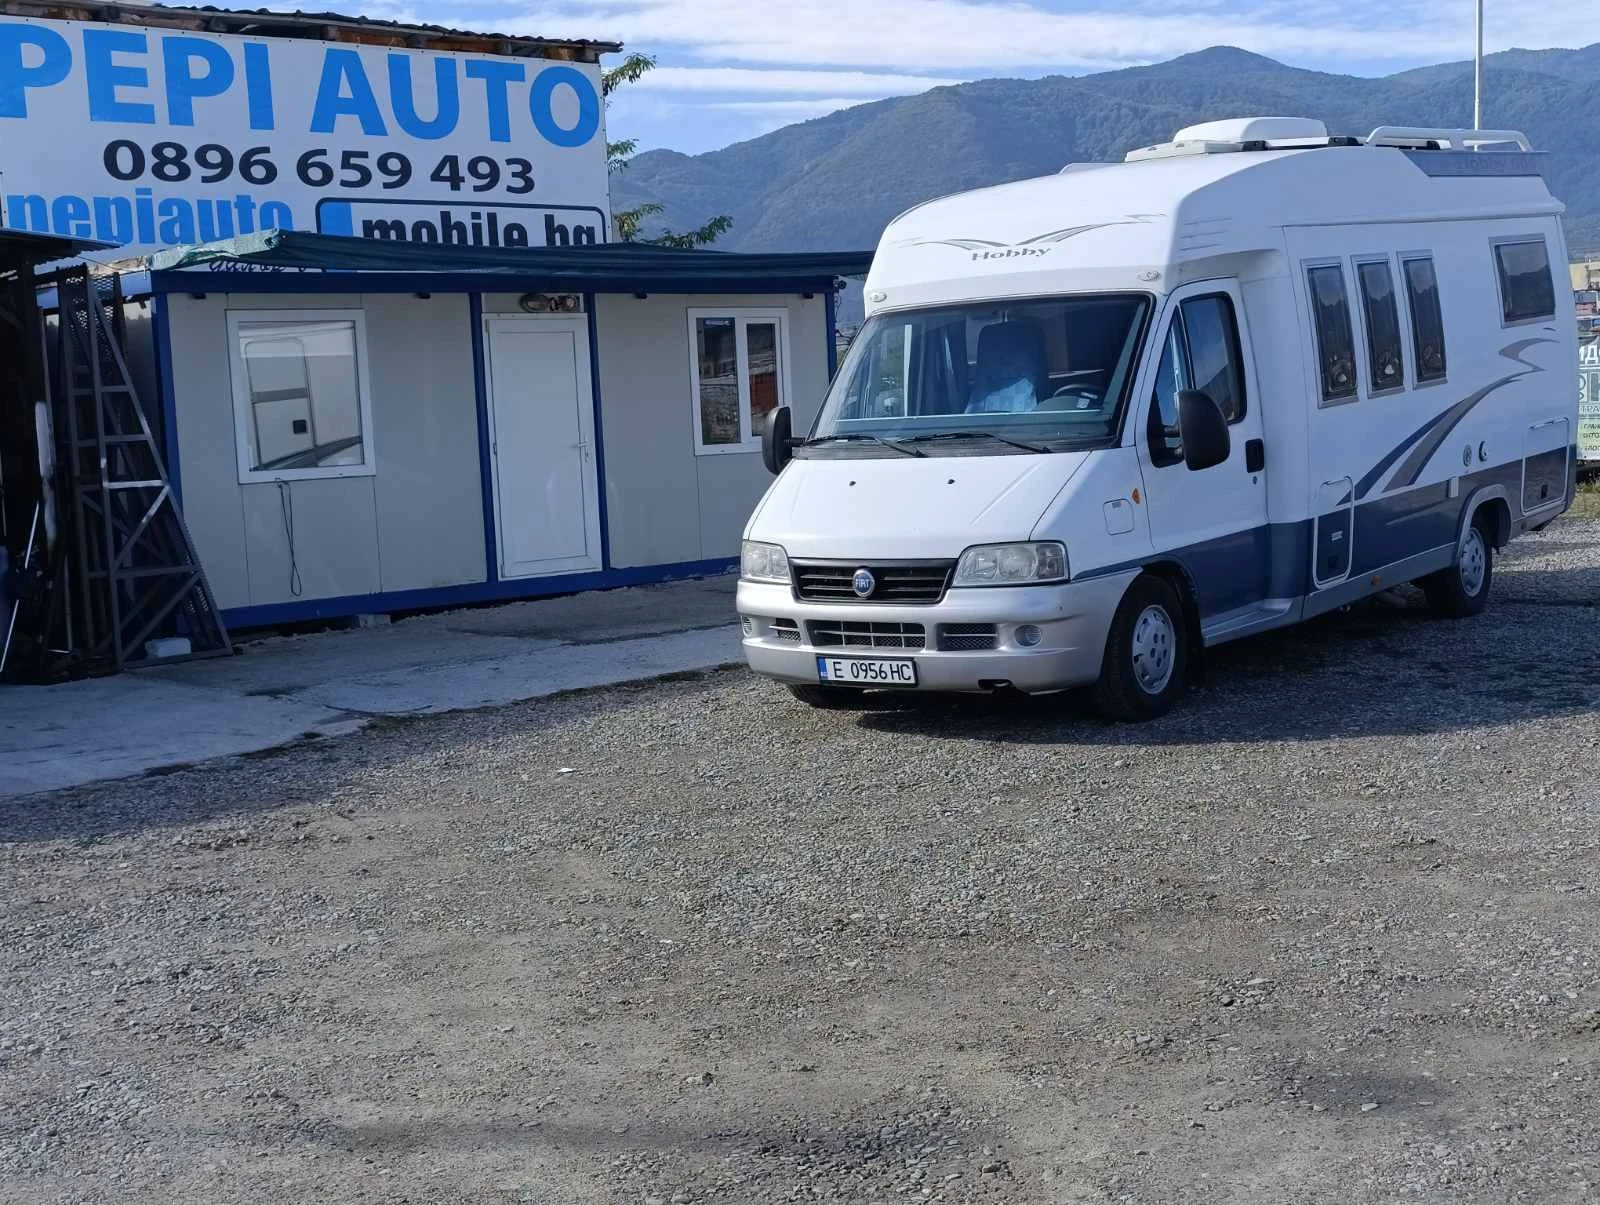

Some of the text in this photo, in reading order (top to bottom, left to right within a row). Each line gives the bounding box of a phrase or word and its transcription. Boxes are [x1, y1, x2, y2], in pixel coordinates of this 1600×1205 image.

[0, 23, 600, 148] PEPI AUTO
[103, 140, 536, 194] 0896 659 493
[972, 248, 1051, 261] Hobby
[856, 578, 869, 588] FIAT
[833, 661, 911, 681] E 0956 HC
